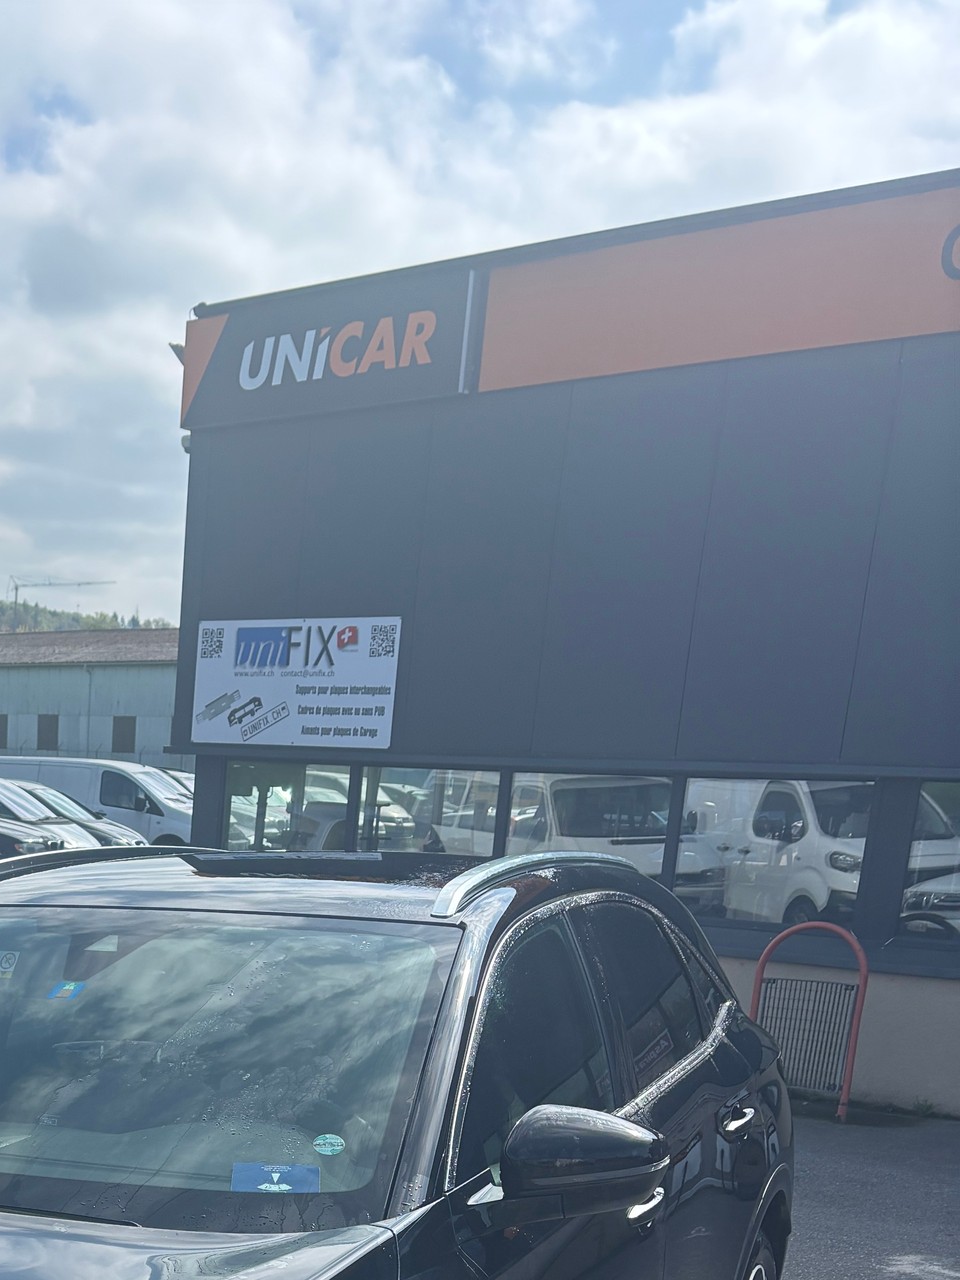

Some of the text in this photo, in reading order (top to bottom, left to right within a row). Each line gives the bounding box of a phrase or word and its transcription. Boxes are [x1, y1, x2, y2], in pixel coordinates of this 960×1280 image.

[236, 625, 337, 668] uniFIX
[280, 670, 335, 678] contact@unifix.ch
[295, 684, 317, 696] Supports
[317, 686, 330, 696] pour
[315, 705, 322, 715] de
[374, 706, 386, 717] PUB
[320, 727, 332, 737] pour
[352, 726, 359, 737] de
